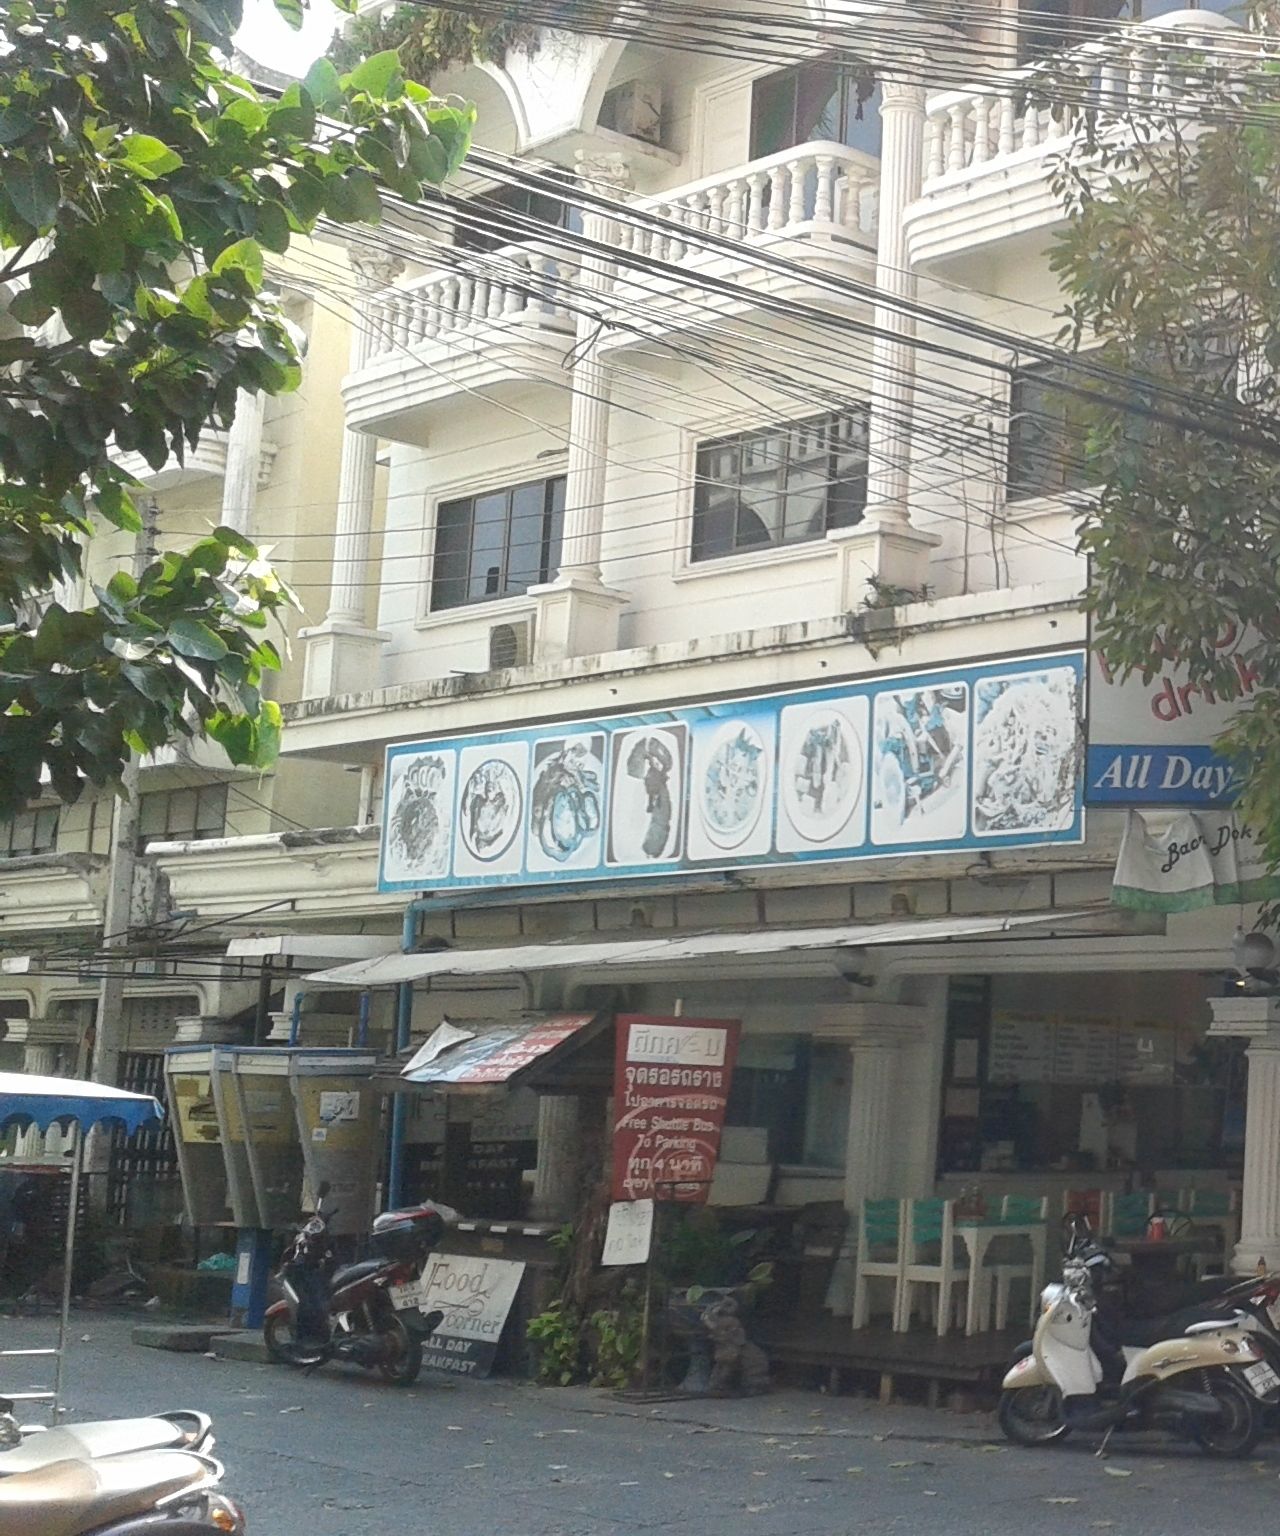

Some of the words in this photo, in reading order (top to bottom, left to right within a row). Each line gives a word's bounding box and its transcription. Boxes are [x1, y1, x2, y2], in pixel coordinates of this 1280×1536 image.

[1151, 653, 1263, 721] drik
[1093, 754, 1152, 789] All
[1159, 755, 1235, 798] Day
[1209, 824, 1252, 856] Dok
[622, 1116, 648, 1130] Free
[651, 1115, 690, 1132] Shuttle
[693, 1117, 714, 1132] Bus
[637, 1133, 652, 1148] To
[655, 1134, 697, 1153] Parking
[424, 1262, 491, 1300] Food
[446, 1312, 500, 1335] corner
[445, 1340, 473, 1354] DAY
